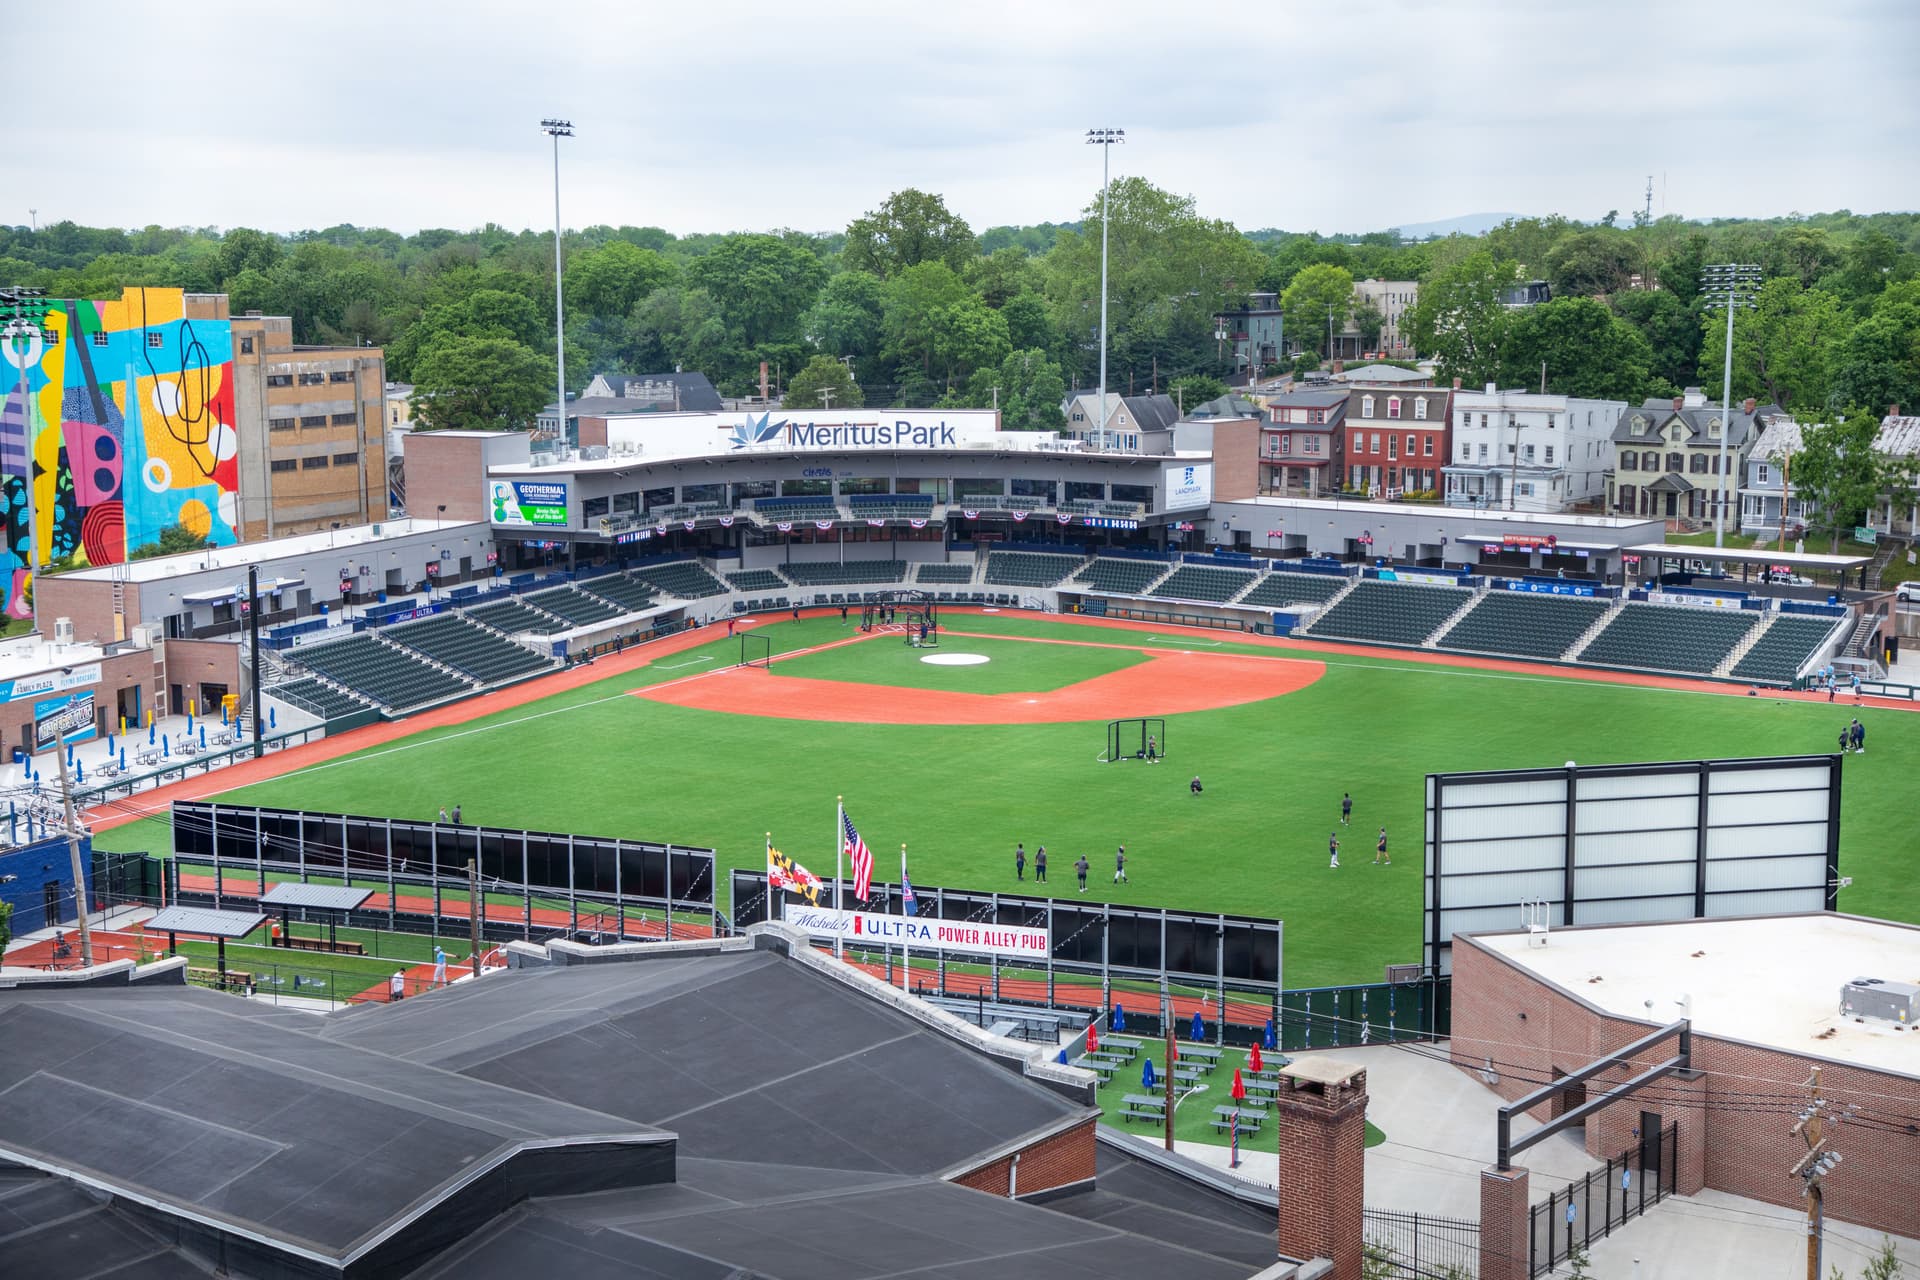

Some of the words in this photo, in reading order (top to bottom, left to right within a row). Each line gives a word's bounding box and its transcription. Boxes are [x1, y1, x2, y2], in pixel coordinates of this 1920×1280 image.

[520, 484, 564, 494] GEOTHERMAL
[416, 607, 433, 617] ULTRA
[16, 684, 35, 693] FAMILY
[36, 680, 53, 690] PLAZA
[868, 919, 932, 940] ULTRA
[938, 926, 979, 944] POWER
[984, 930, 1017, 948] ALLEY
[1022, 934, 1046, 950] PUB
